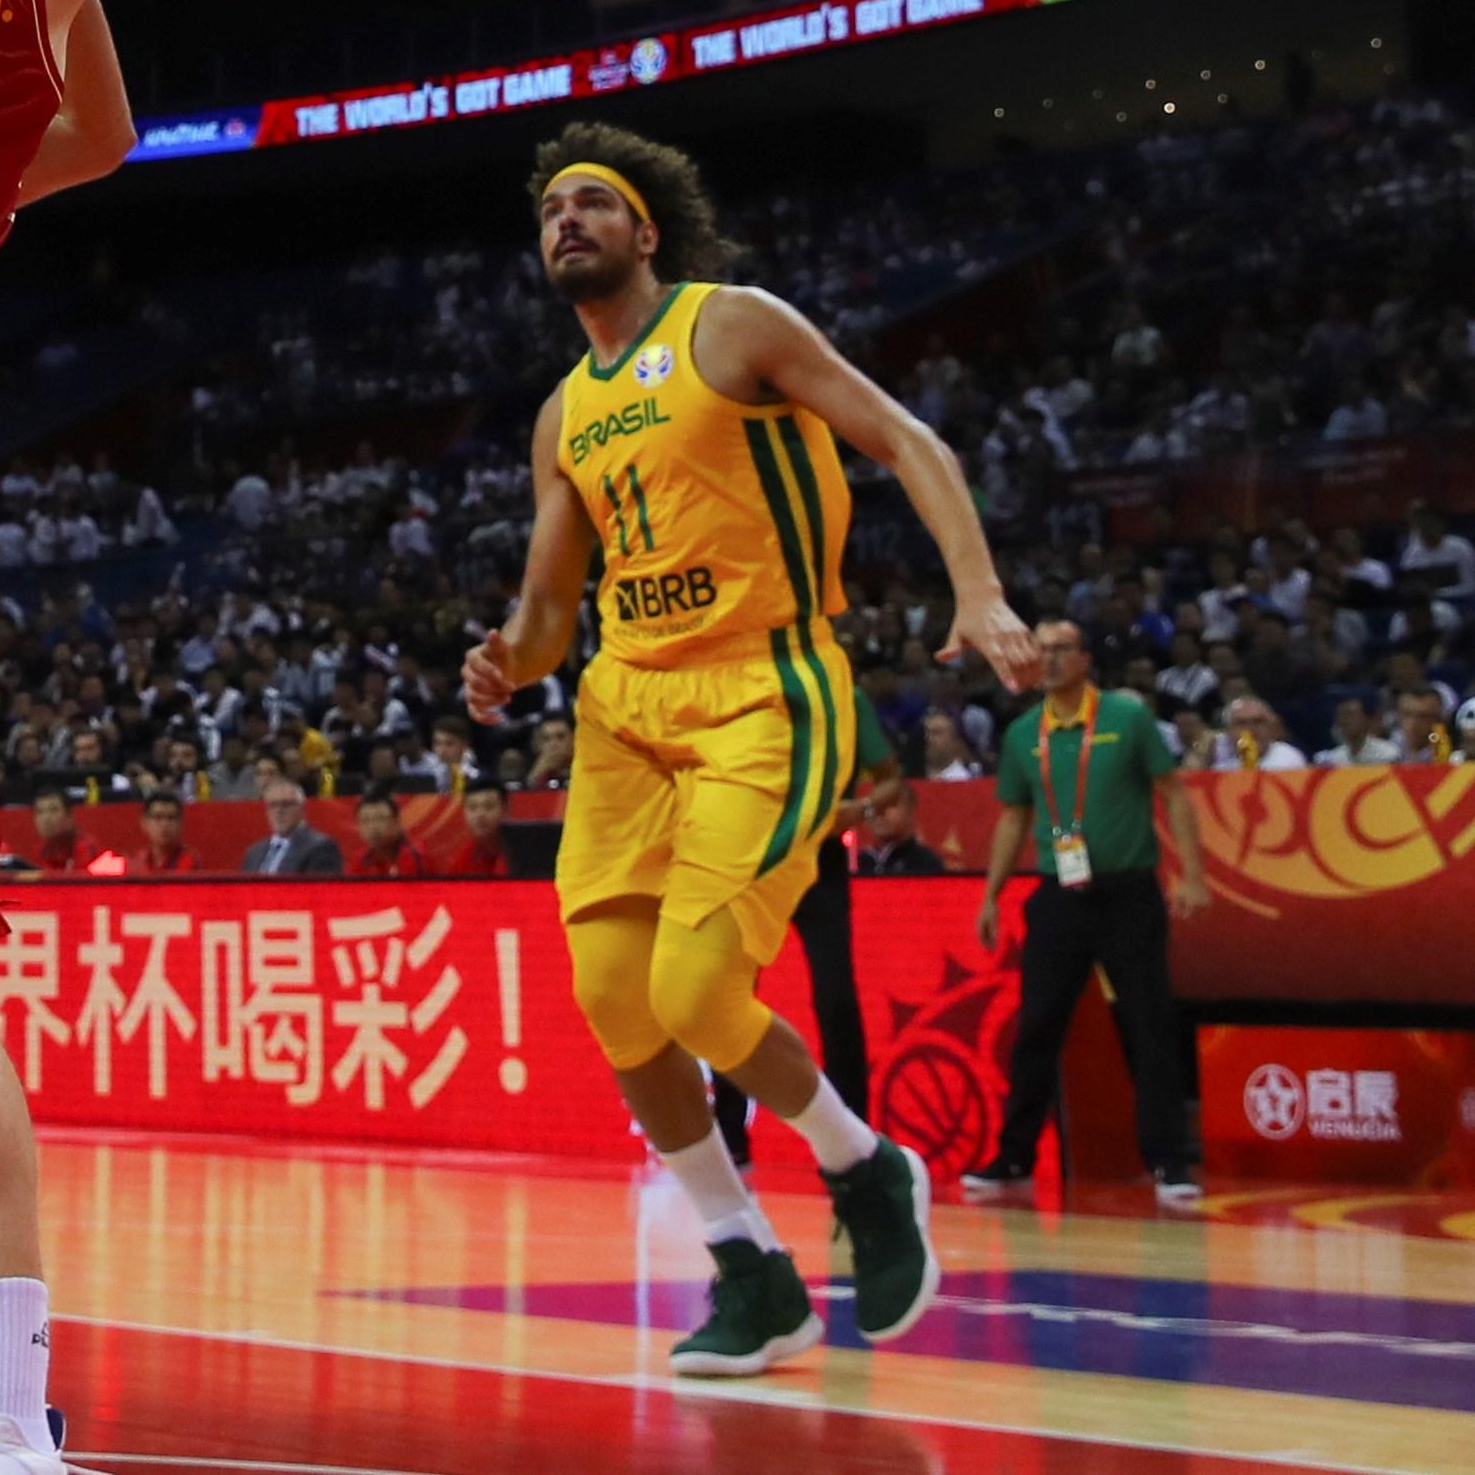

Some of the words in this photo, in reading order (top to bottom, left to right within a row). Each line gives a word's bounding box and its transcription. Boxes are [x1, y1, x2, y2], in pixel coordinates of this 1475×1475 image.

[691, 29, 739, 68] THE
[741, 2, 848, 61] WORLD'S
[295, 103, 338, 137] THE
[345, 83, 448, 128] WORLD'S
[454, 75, 499, 114] GOT
[502, 64, 572, 107] GAME
[570, 397, 671, 465] BRASIL
[604, 463, 654, 556] 11
[641, 566, 717, 618] BRB
